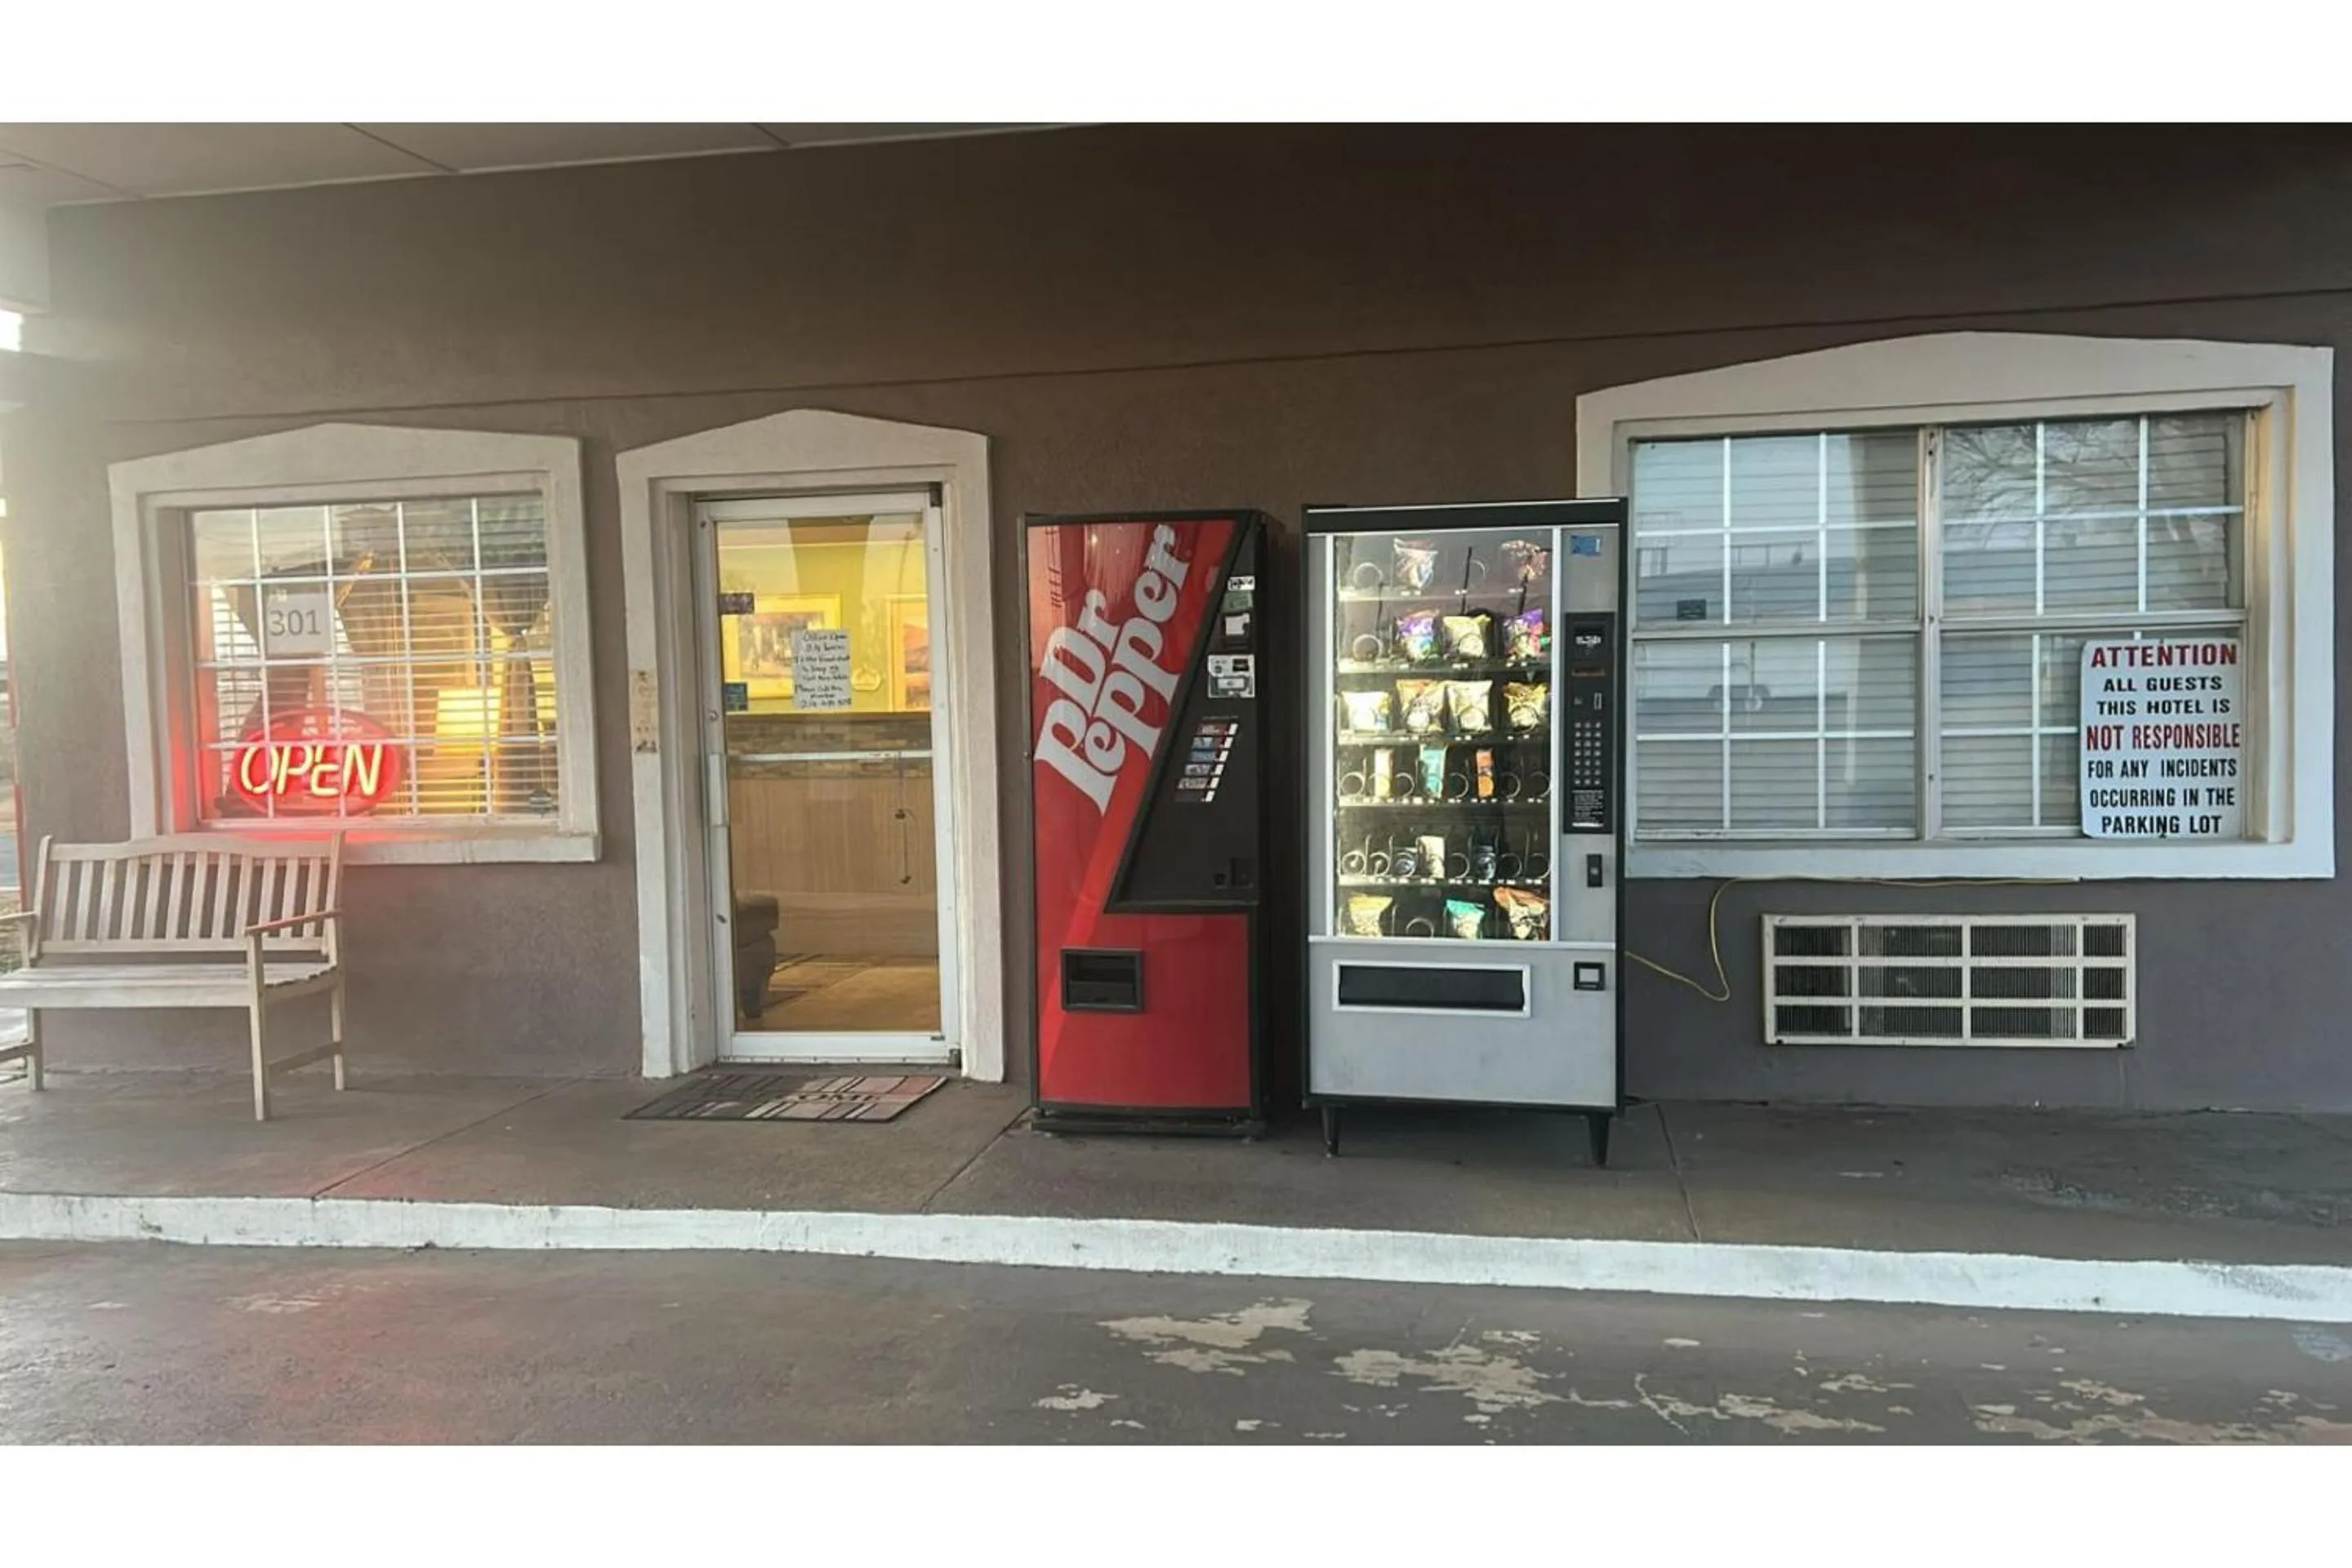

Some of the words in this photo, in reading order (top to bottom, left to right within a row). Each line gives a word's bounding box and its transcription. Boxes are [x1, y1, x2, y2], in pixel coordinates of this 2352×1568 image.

[270, 609, 322, 636] 301
[1040, 588, 1120, 717] Dr
[2091, 643, 2237, 668] ATTENTION
[1033, 523, 1189, 816] Pepper
[2103, 678, 2136, 693] ALL
[2146, 675, 2222, 692] GUESTS
[2096, 701, 2136, 715] THIS
[2147, 699, 2203, 715] HOTEL
[2213, 698, 2230, 714] IS
[2087, 725, 2124, 751] NOT
[2132, 724, 2240, 750] RESPONSIBLE
[240, 743, 382, 797] OPEN
[2088, 760, 2113, 778] FOR
[2121, 760, 2149, 777] ANY
[2161, 759, 2237, 777] INCIDENTS
[2090, 788, 2176, 808] OCCURRING
[2184, 788, 2198, 806] IN
[2206, 787, 2234, 805] THE
[2102, 816, 2180, 834] PARKING
[2189, 815, 2223, 833] LOT
